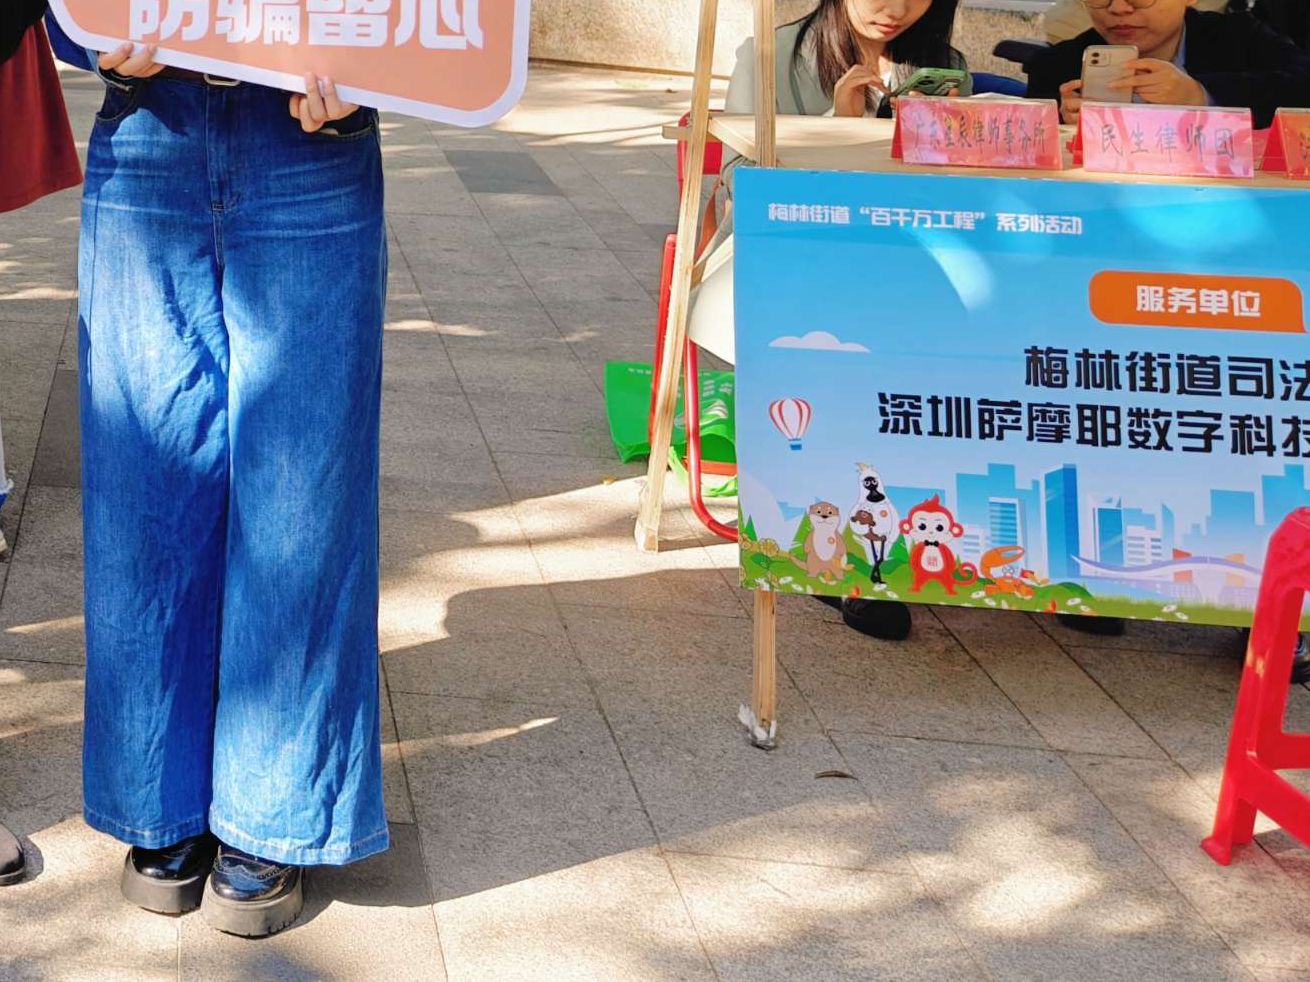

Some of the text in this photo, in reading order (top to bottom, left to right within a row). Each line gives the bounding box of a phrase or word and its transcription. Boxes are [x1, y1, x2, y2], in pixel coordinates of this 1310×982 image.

[768, 203, 1082, 235] 梅林街道“百千万工程”系列活动
[1136, 285, 1261, 317] 服务单位
[1024, 346, 1310, 402] 梅林街道司法
